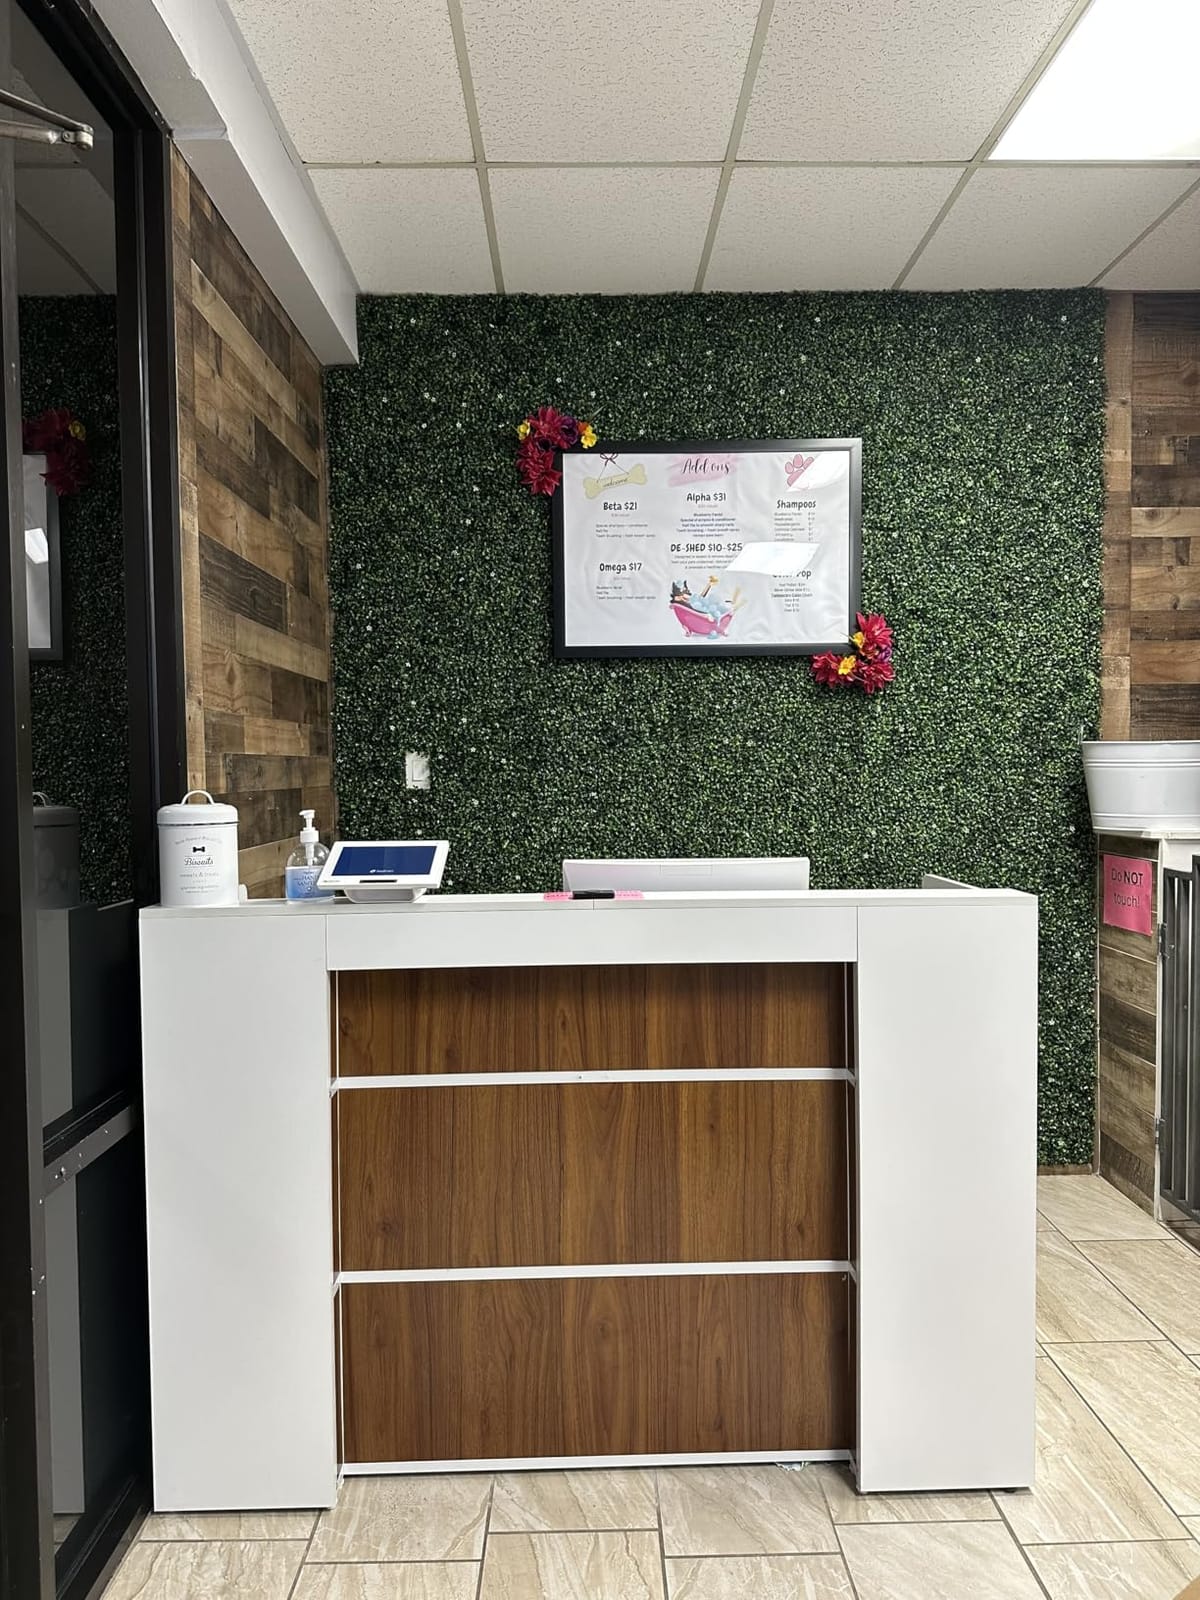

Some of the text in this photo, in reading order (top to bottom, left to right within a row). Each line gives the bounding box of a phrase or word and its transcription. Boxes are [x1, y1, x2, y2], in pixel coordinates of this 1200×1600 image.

[682, 458, 708, 474] Add
[686, 492, 727, 504] Alpha $31
[603, 501, 638, 510] Beta $21
[776, 499, 817, 511] Shampoos
[670, 543, 706, 552] DE-SHED
[599, 562, 642, 575] Omega $17
[184, 857, 214, 866] Biscuits
[1111, 868, 1144, 885] Do NOT
[1113, 892, 1140, 909] touch!
